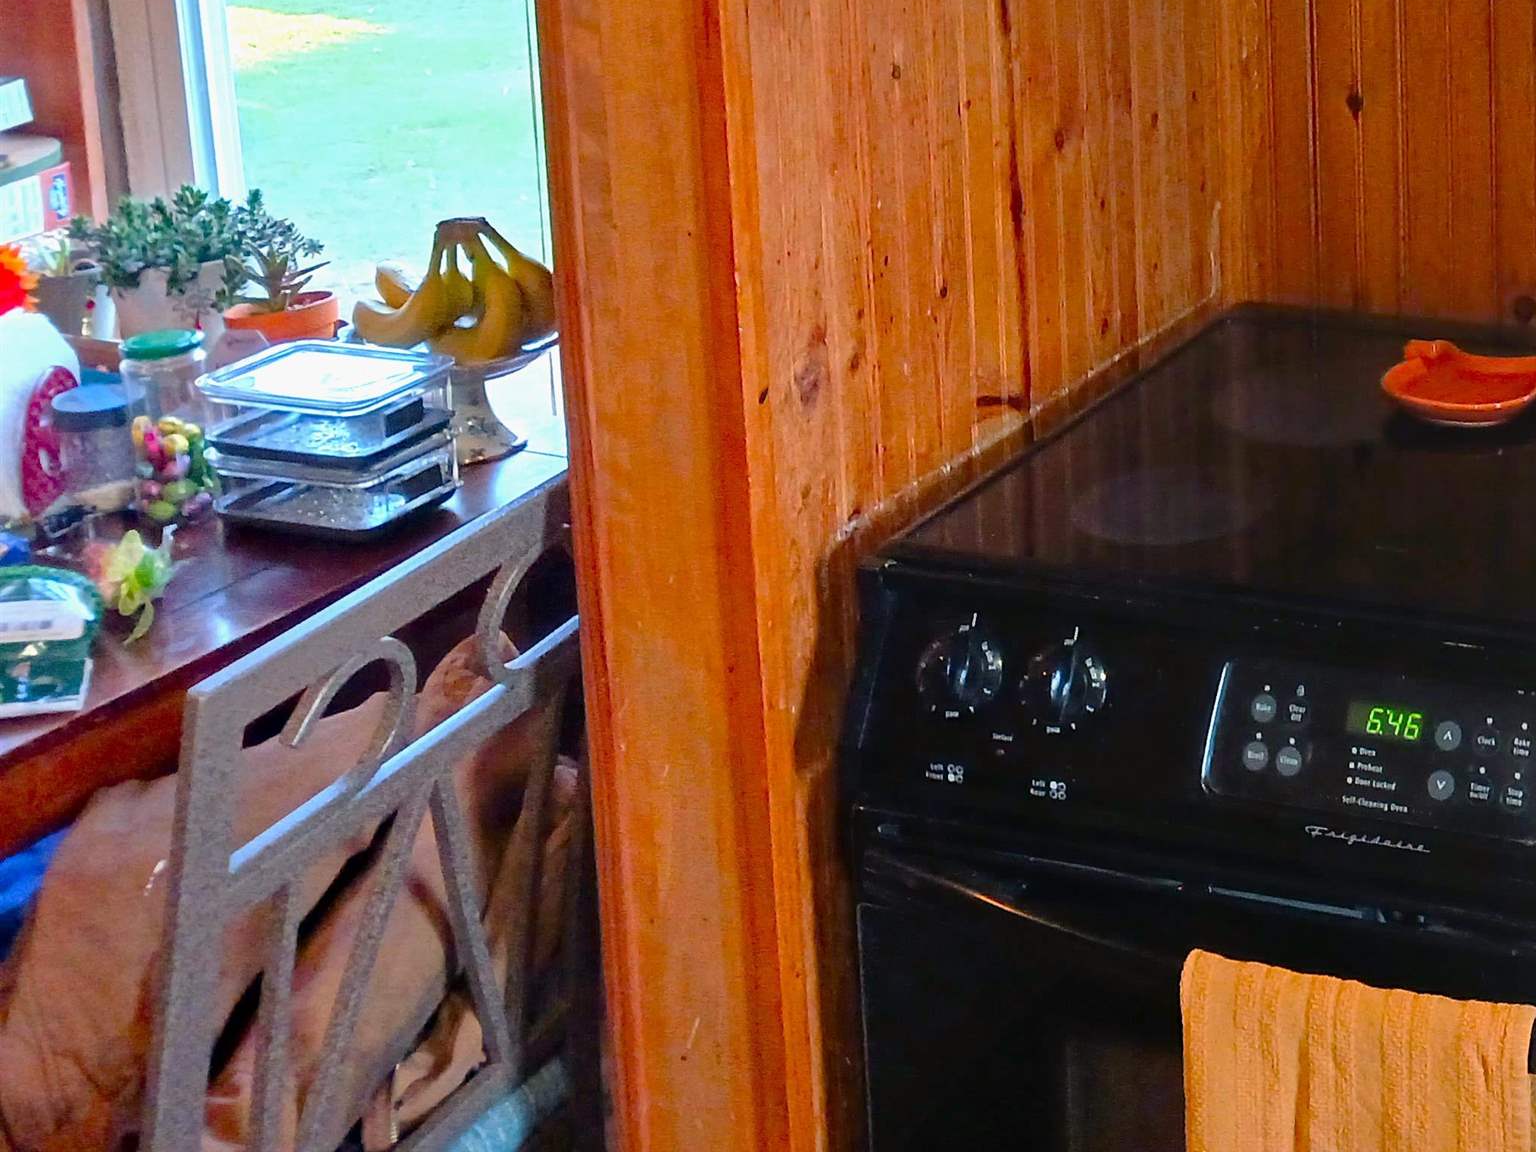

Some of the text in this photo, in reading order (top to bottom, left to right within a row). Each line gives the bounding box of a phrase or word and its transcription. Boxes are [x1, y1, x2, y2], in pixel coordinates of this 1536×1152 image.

[1366, 707, 1422, 740] 6:46
[1477, 735, 1496, 747] Clock
[1359, 747, 1376, 757] Oven
[1354, 776, 1397, 790] Door Locked
[1304, 825, 1431, 853] Frigidaire
